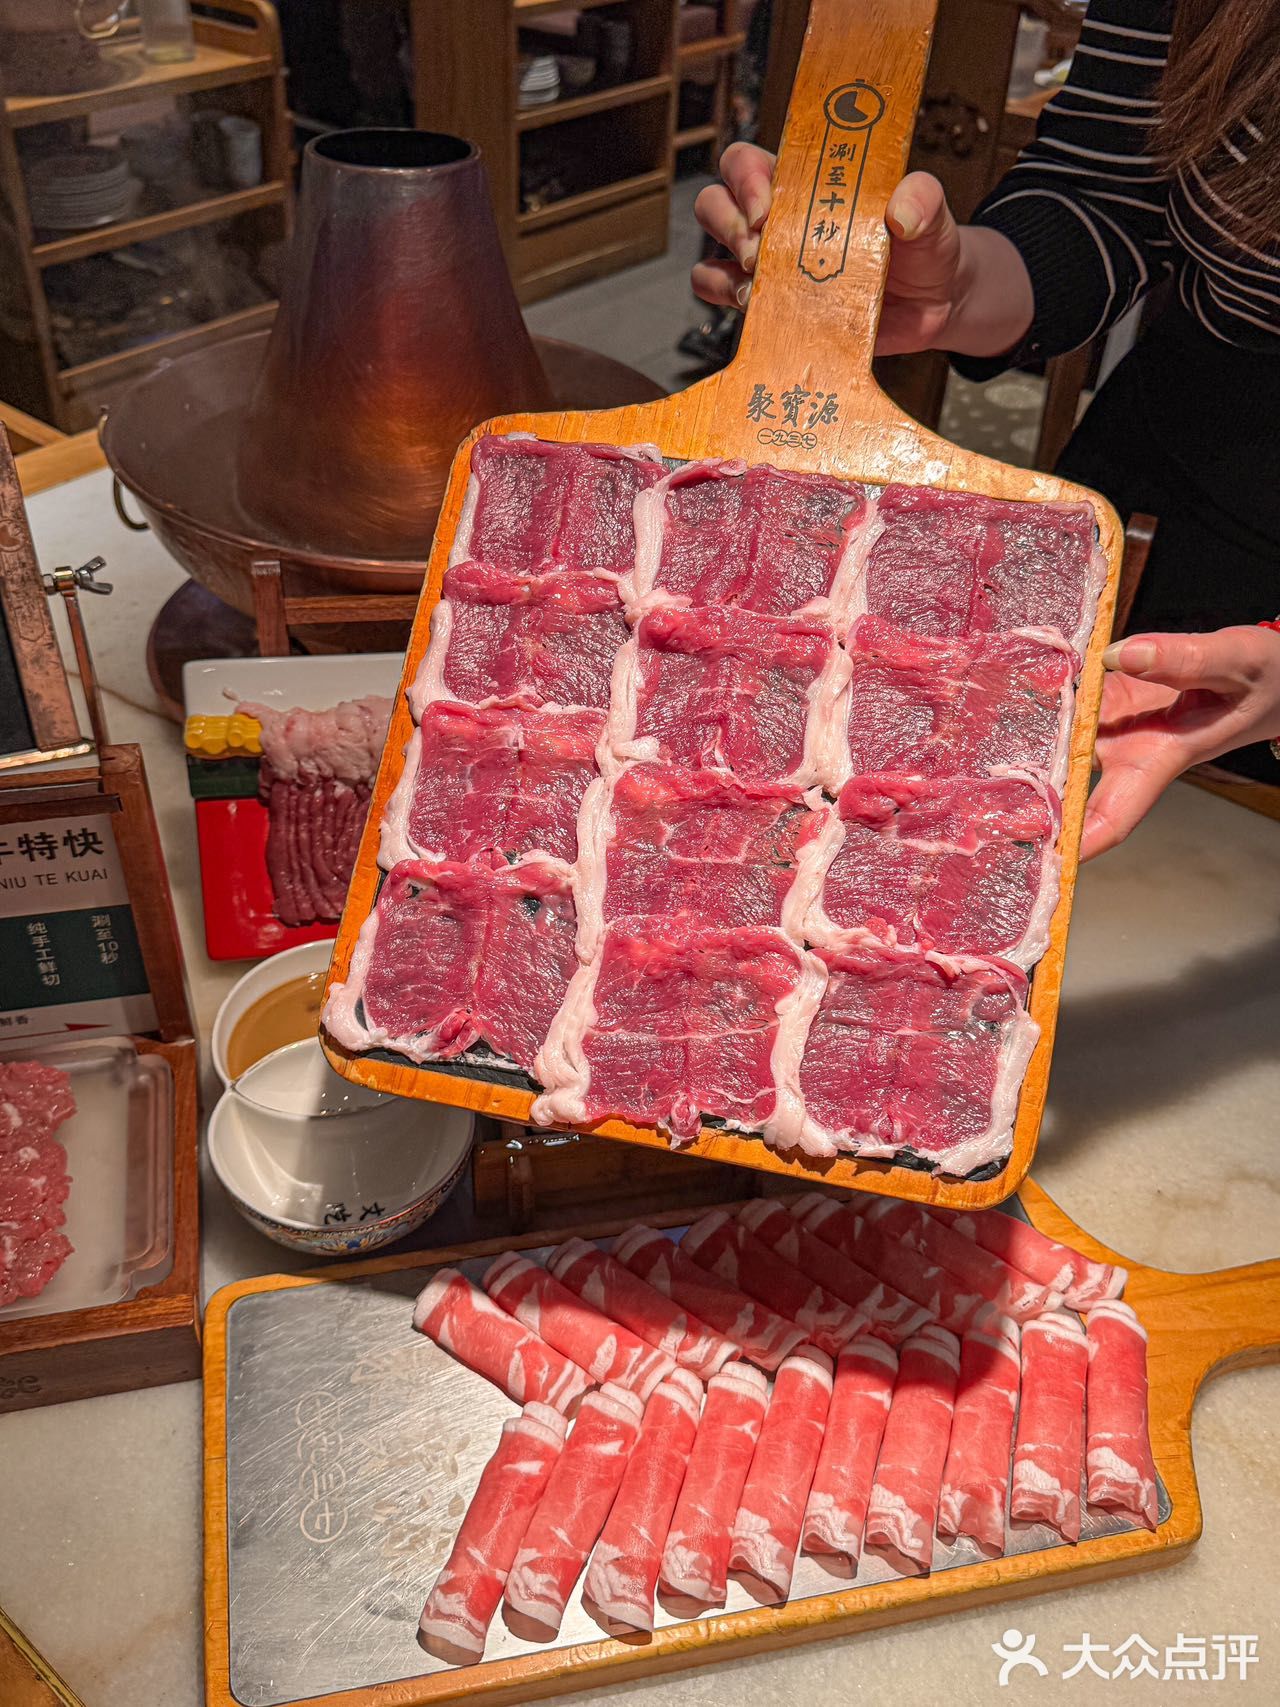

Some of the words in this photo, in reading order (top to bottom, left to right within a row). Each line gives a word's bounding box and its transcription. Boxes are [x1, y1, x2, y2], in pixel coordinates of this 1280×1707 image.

[812, 143, 857, 242] 涮至十秒
[757, 428, 817, 449] 一九三七
[34, 873, 58, 886] TE
[65, 868, 108, 882] KUAI
